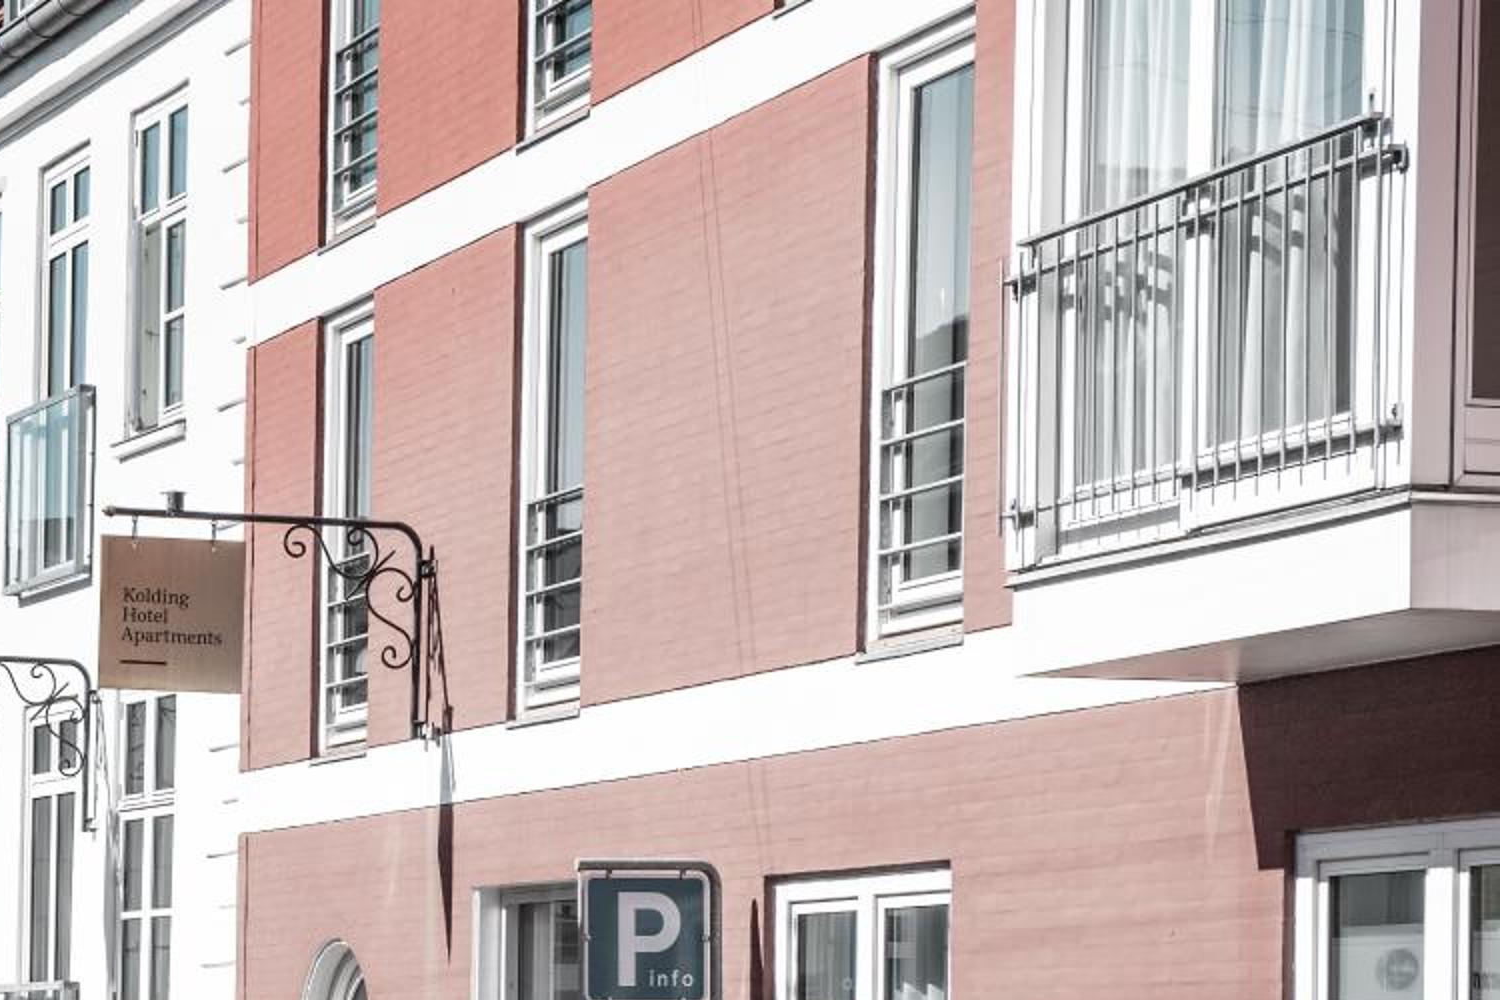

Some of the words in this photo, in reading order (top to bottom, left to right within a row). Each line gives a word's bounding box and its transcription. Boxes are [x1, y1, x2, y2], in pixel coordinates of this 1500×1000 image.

[123, 586, 190, 608] Kolding
[123, 607, 168, 624] Hotel
[121, 626, 223, 646] Apartments
[617, 891, 681, 987] P
[648, 969, 694, 987] info
